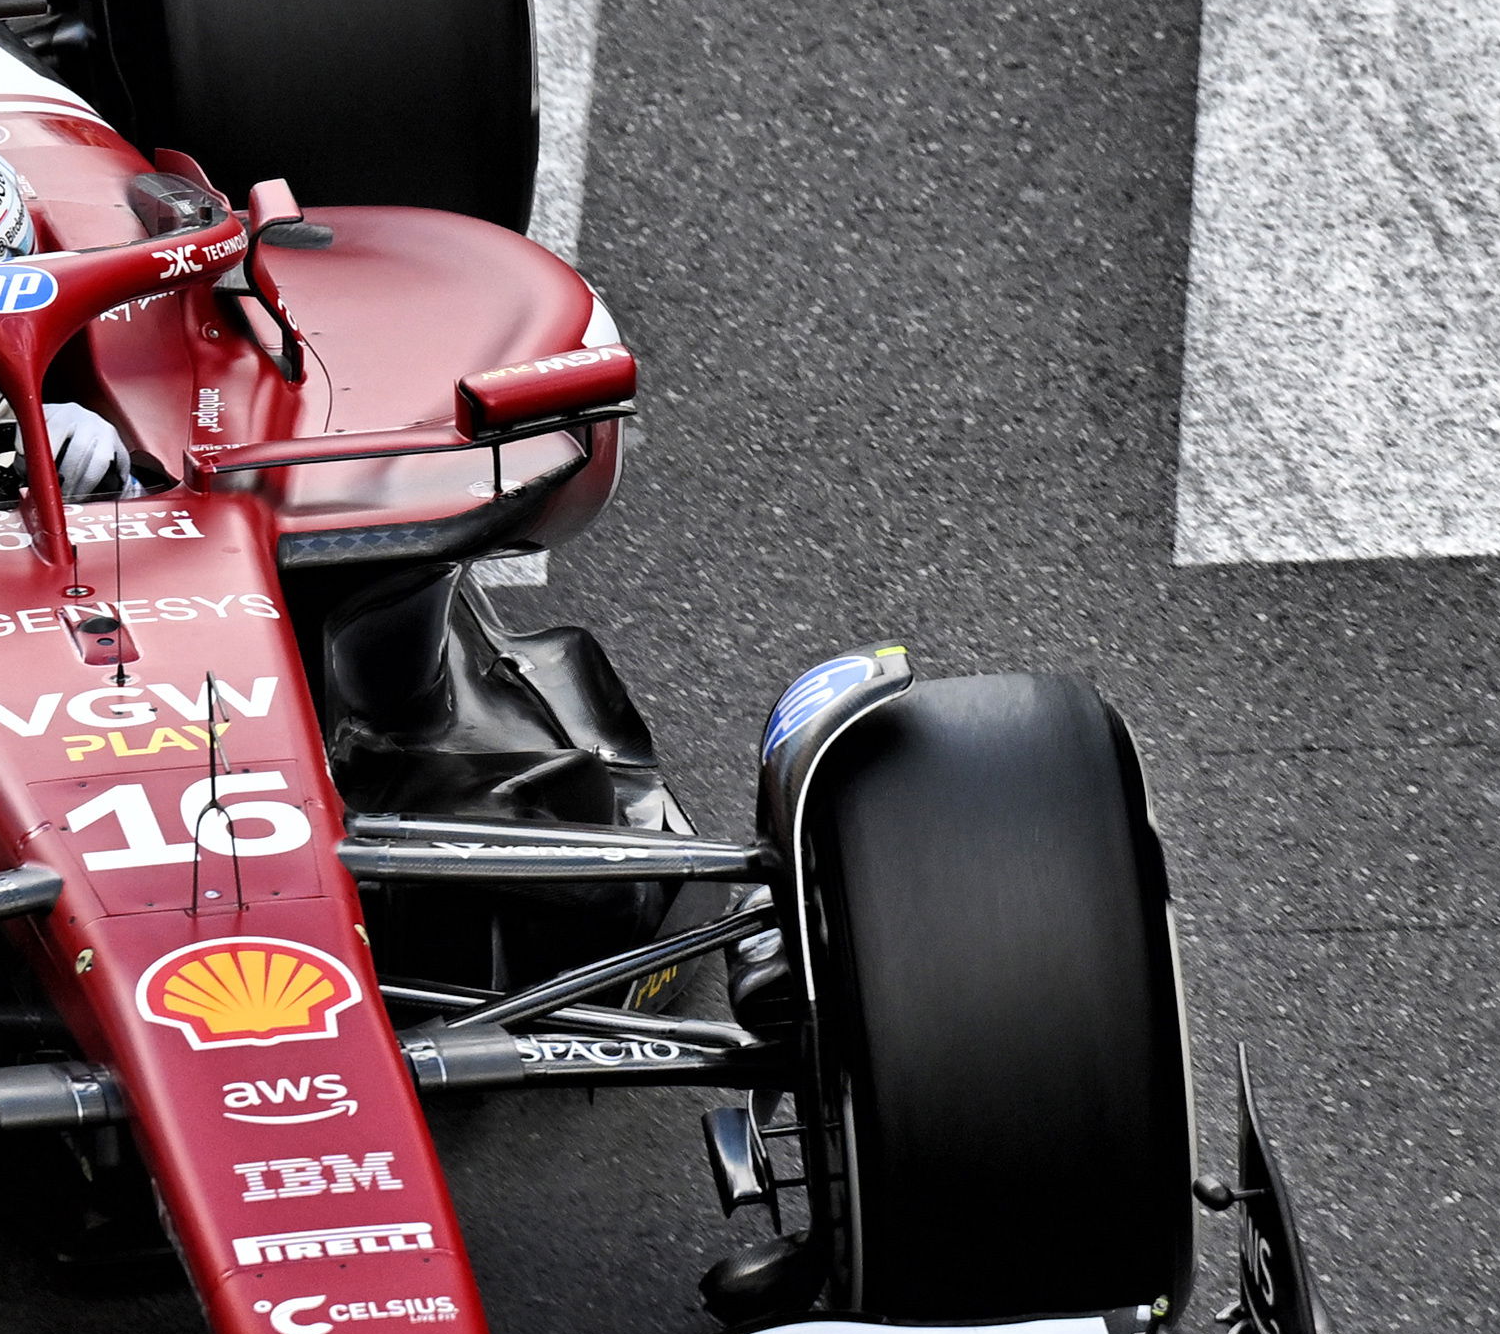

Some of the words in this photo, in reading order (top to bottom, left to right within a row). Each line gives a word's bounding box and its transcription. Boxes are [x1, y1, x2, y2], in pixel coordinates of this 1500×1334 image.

[533, 347, 631, 374] VGW
[191, 387, 226, 428] ambipar
[77, 510, 190, 523] NASTRO
[61, 722, 232, 761] PLAY
[64, 770, 313, 872] 16
[488, 842, 652, 862] vantage
[515, 1039, 681, 1067] SPACIO
[222, 1071, 349, 1108] aws
[232, 1150, 404, 1203] IBM
[231, 1220, 436, 1266] PIRELLI
[328, 1295, 456, 1322] CELSIUS
